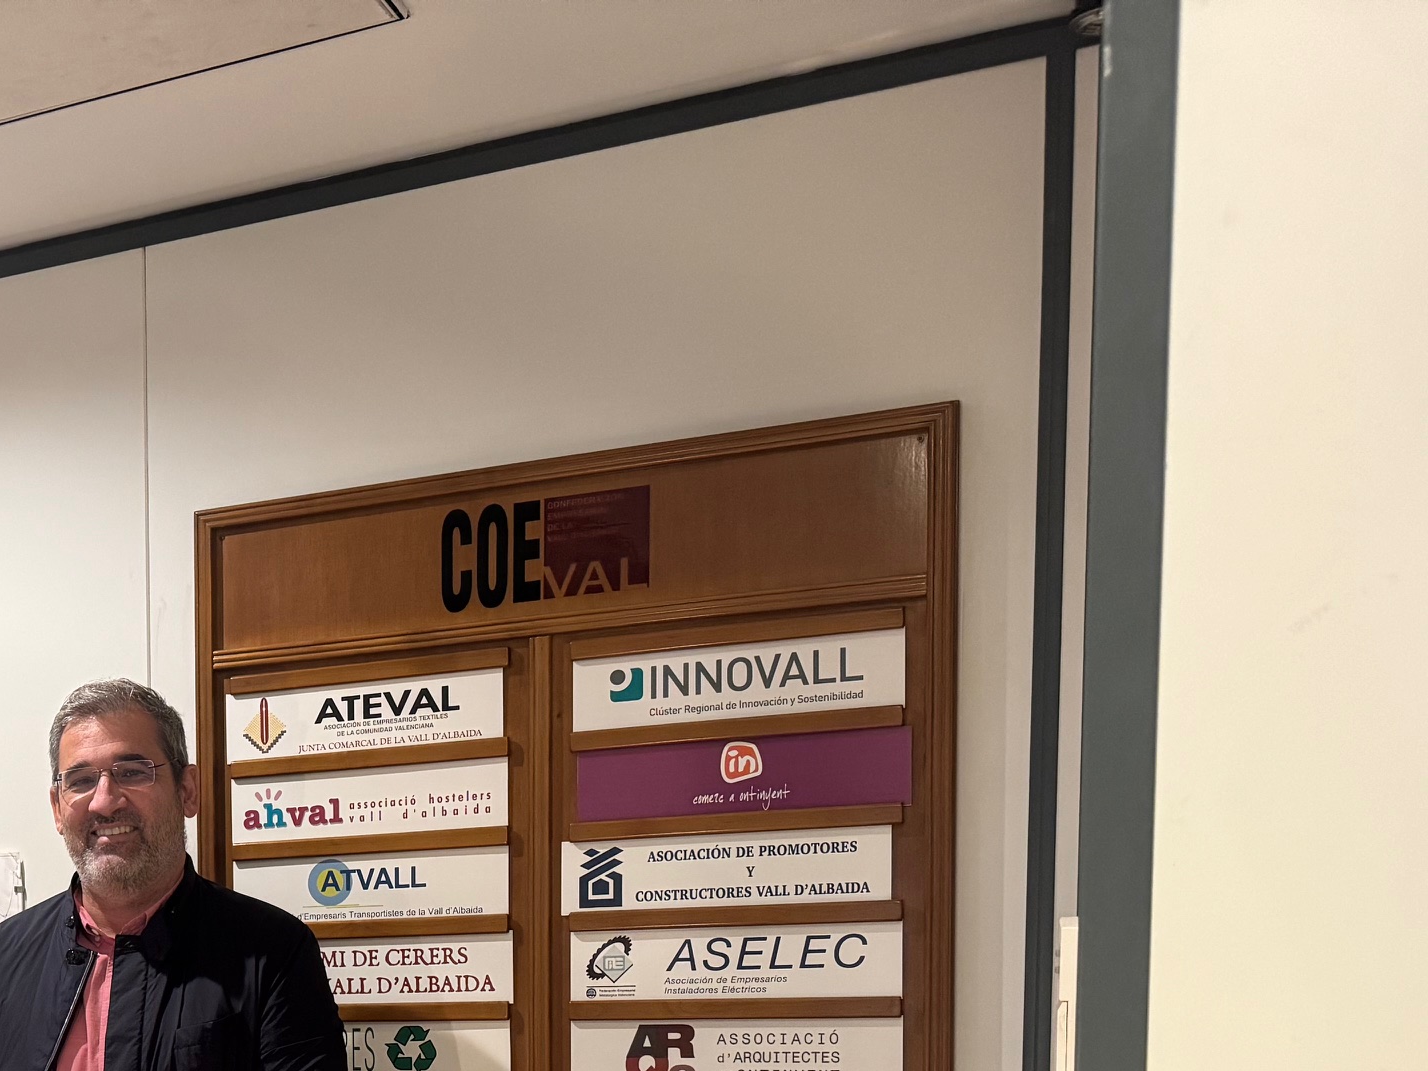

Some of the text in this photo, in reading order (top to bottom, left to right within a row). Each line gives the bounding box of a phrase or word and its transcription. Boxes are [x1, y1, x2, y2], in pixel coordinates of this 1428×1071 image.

[651, 647, 864, 700] INNOVALL
[314, 685, 460, 724] ATEVAL
[649, 690, 864, 717] Clúster Regional de Innovación y Sostenibilidad
[323, 721, 361, 731] ASOCIACIÓN
[372, 715, 418, 726] EMPRESARIOS
[419, 713, 449, 721] TEXTILES
[356, 726, 393, 735] COMUNIDAD
[394, 722, 434, 733] VALENCIANA
[298, 729, 483, 754] JUNTA COMARCAL DE LA VALL D'ALBAIDA
[349, 790, 492, 811] associació hostelers
[729, 793, 735, 802] a
[739, 784, 790, 811] ontinyent
[243, 798, 344, 830] ahval
[349, 804, 492, 823] vall d'albaida
[647, 840, 858, 863] ASOCIACIÓN DE PROMOTORES
[321, 866, 427, 893] ATVALL
[746, 866, 756, 878] Y
[635, 886, 752, 903] CONSTRUCTORES
[756, 884, 790, 898] VALL
[349, 909, 404, 919] Transportistes
[406, 909, 416, 917] de
[418, 908, 426, 916] la
[427, 907, 444, 915] Vall
[445, 906, 484, 915] d'Albaida
[321, 946, 468, 968] MI DE CERERS
[666, 933, 868, 972] ASELEC
[664, 974, 788, 985] Asociación de Empresarios
[664, 984, 767, 995] Instaladores Eléctricos
[716, 1030, 840, 1045] ASSOCIACIÓ
[343, 1027, 376, 1071] ES
